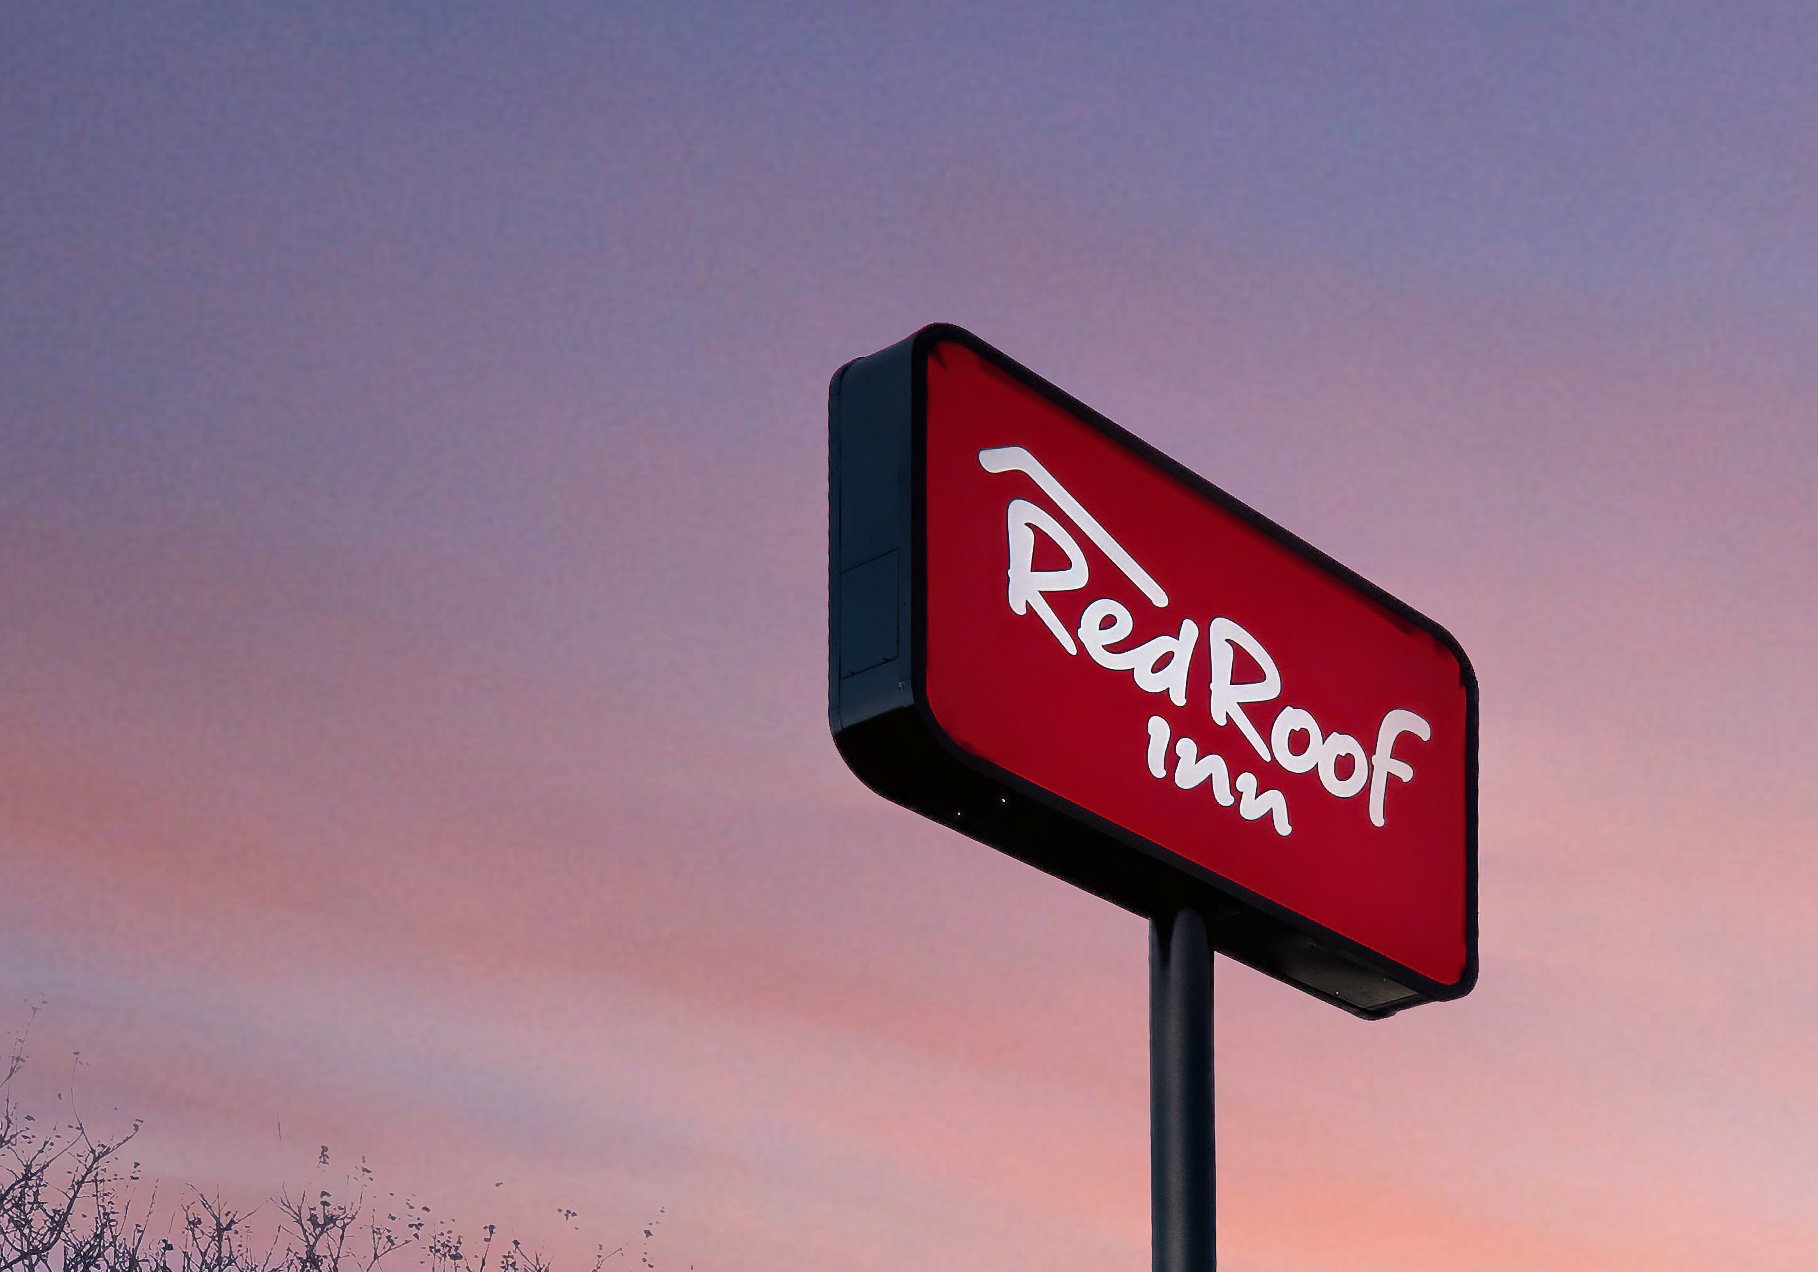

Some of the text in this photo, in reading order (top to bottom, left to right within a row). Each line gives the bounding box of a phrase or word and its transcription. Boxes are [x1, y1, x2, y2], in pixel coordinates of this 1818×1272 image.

[1008, 499, 1431, 827] Red Roof
[1147, 715, 1292, 836] Inn
